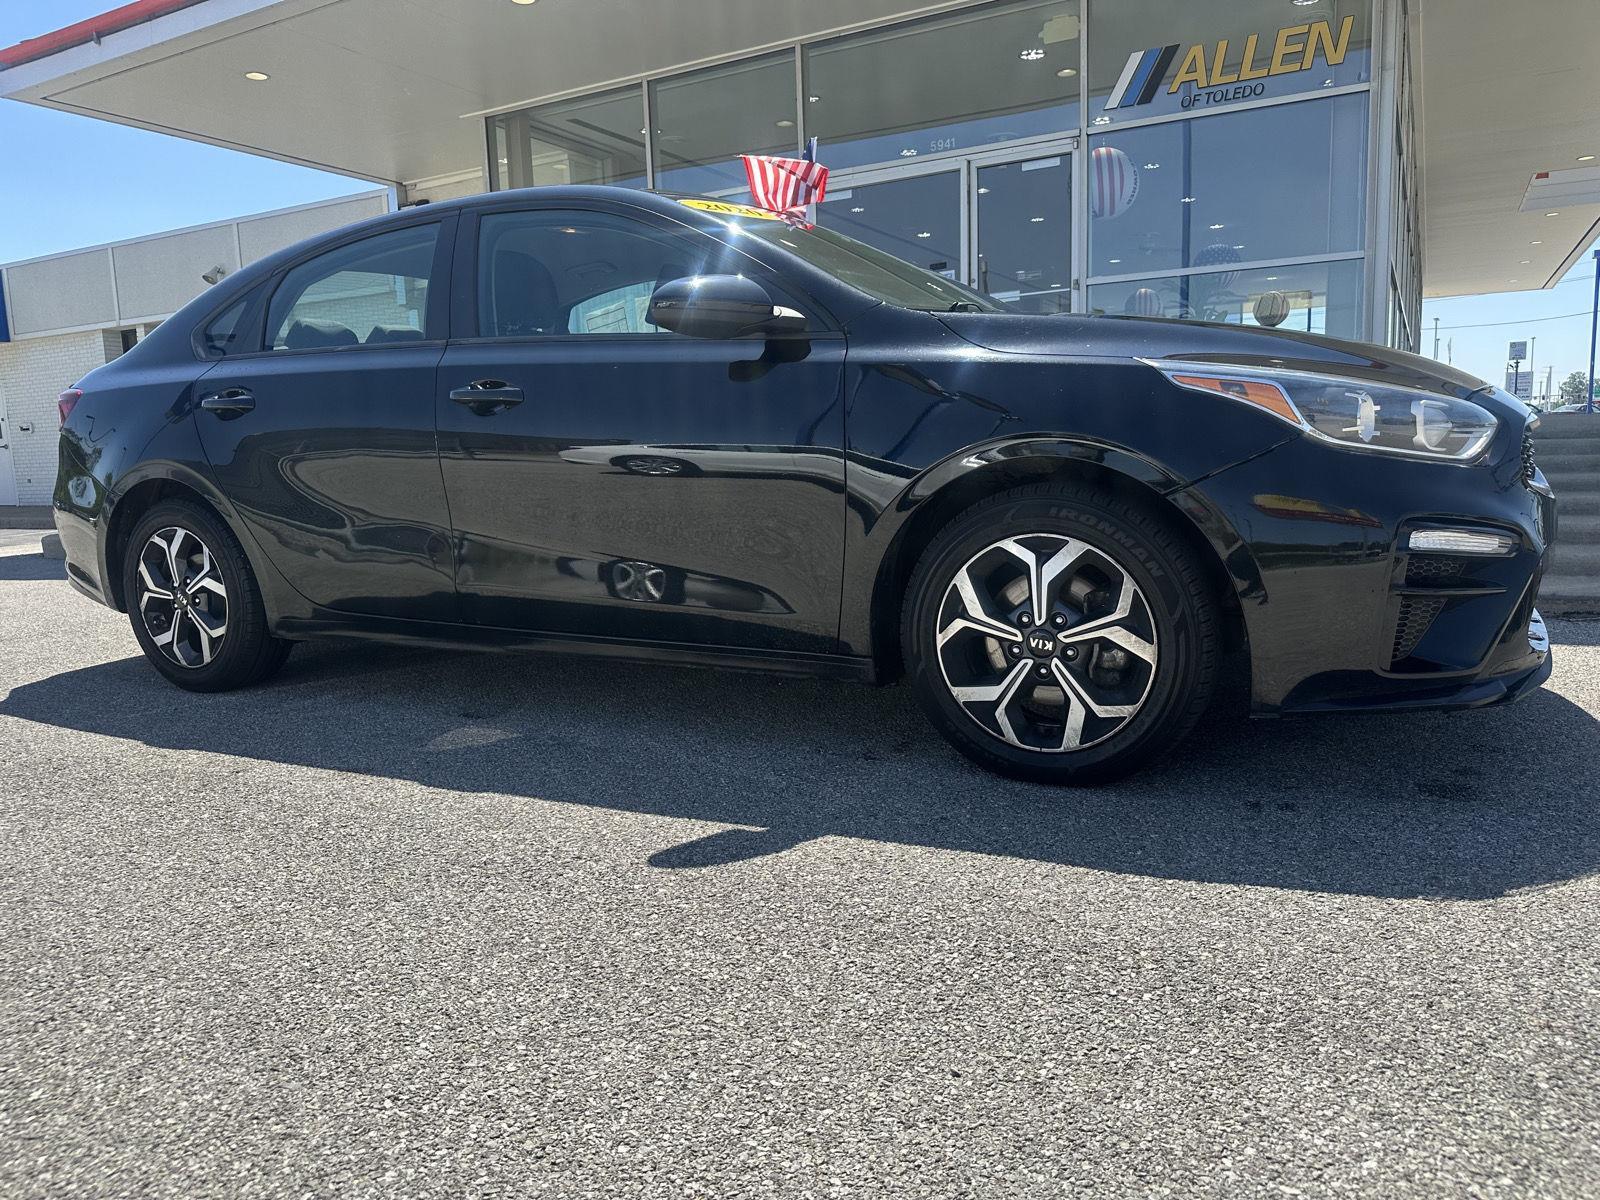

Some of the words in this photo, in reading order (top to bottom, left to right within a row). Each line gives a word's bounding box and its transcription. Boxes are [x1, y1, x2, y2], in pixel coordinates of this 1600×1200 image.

[1166, 15, 1355, 95] ALLEN
[1180, 95, 1202, 108] OF
[1206, 82, 1265, 103] TOLEDO
[930, 138, 956, 152] 5941
[1048, 506, 1165, 577] IRONMAN
[1030, 637, 1053, 650] KIA
